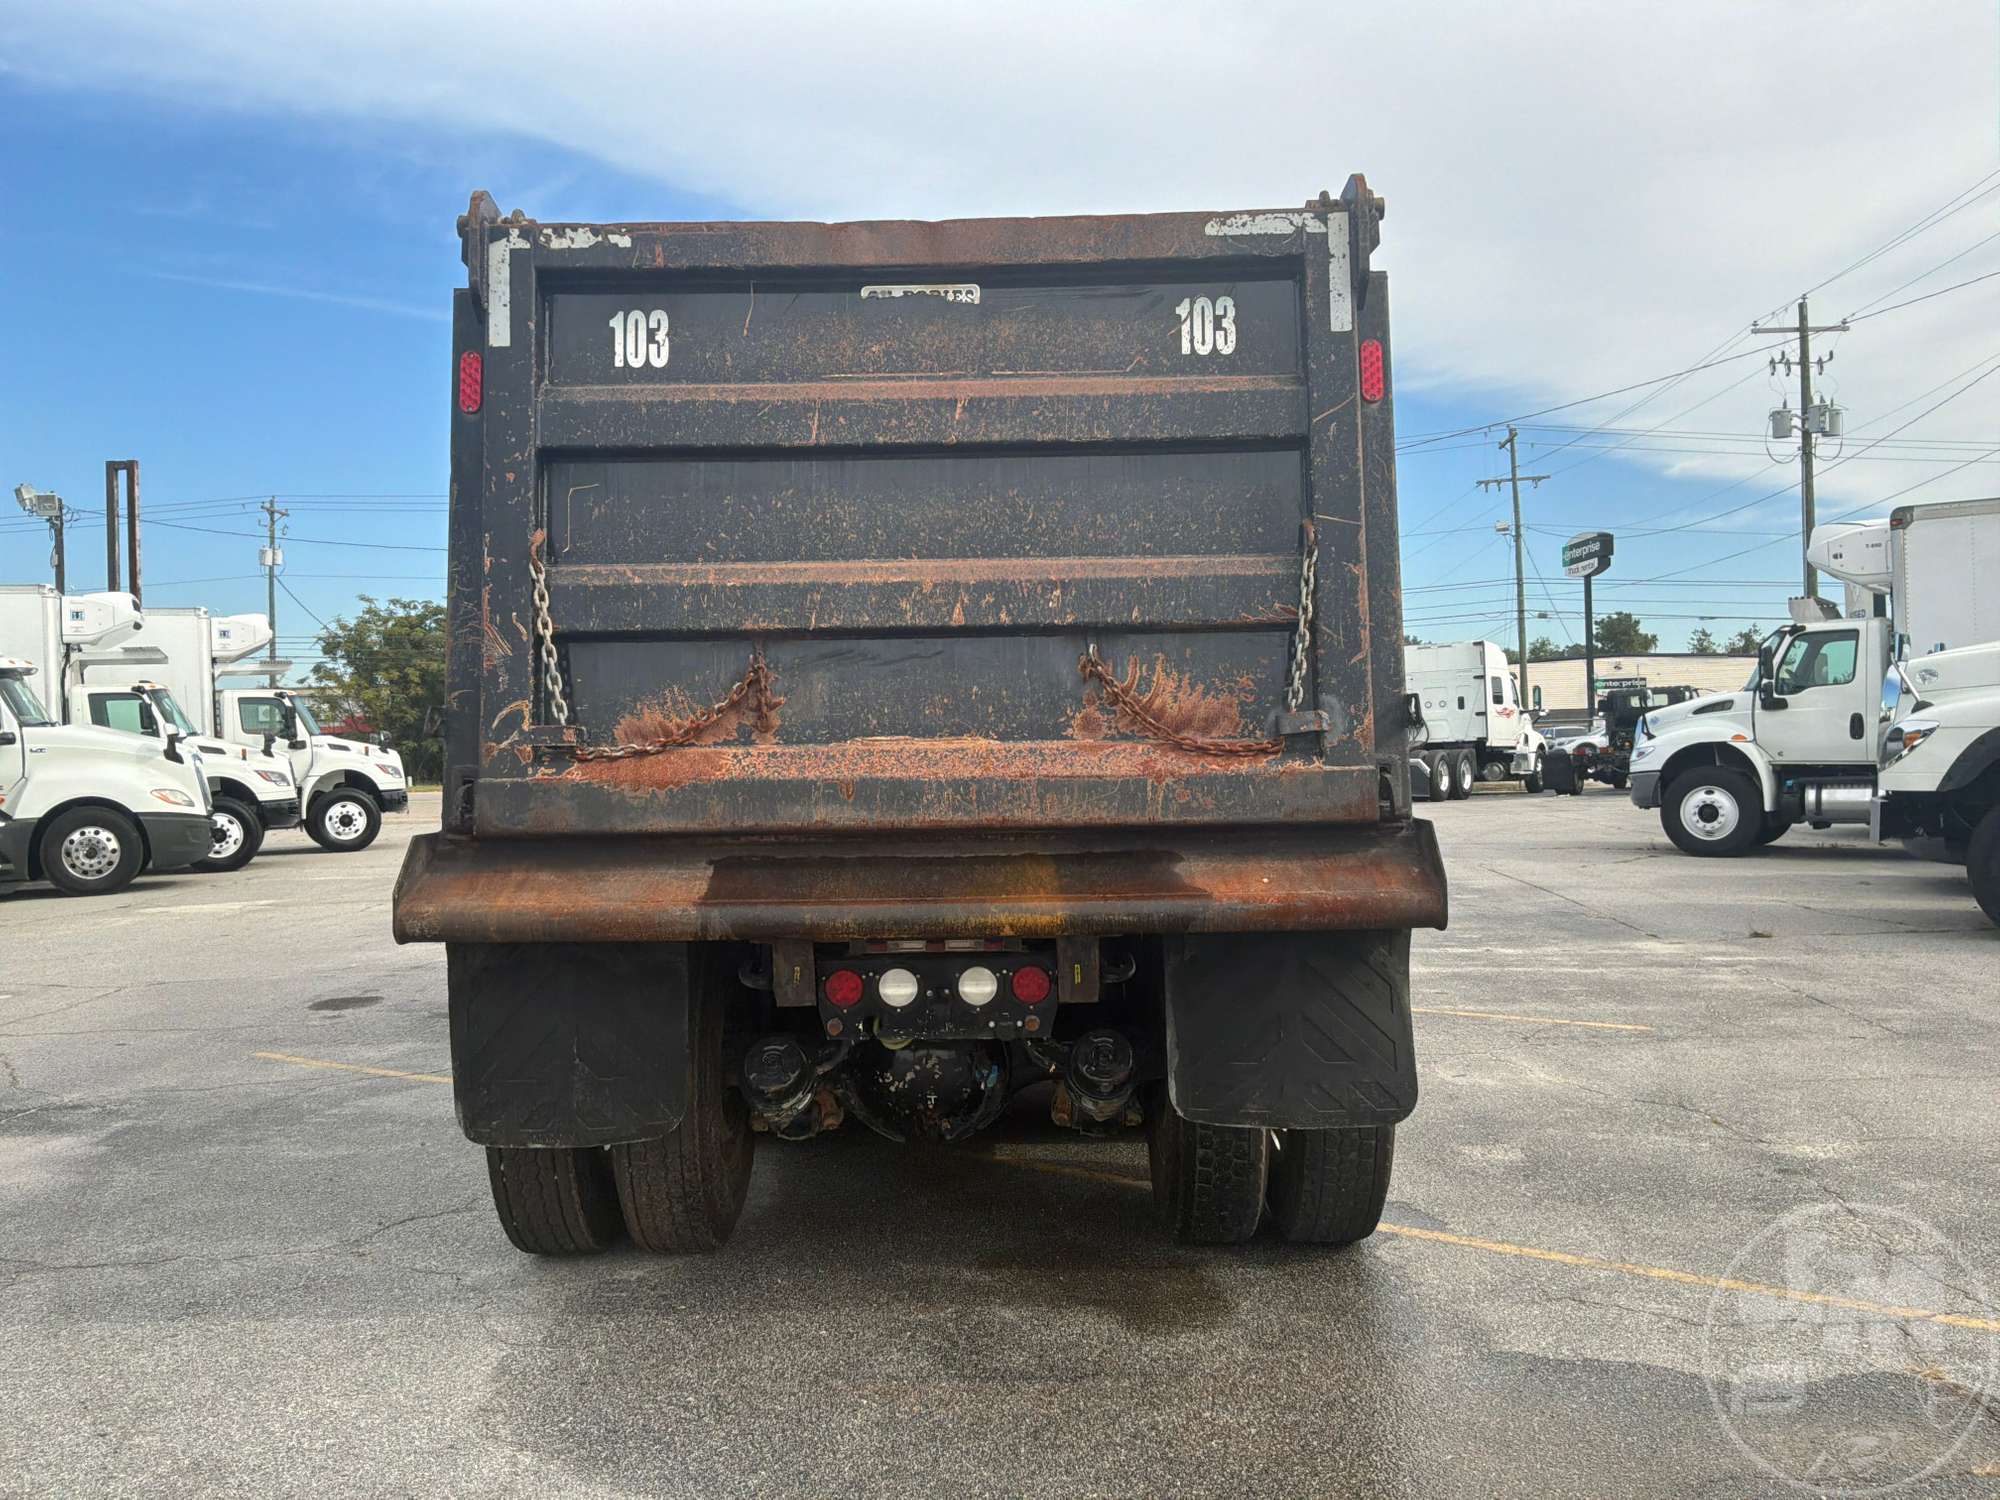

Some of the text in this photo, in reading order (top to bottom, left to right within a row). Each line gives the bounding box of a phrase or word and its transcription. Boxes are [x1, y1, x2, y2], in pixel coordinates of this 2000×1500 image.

[608, 309, 670, 369] 103
[1175, 296, 1236, 356] 103
[1563, 541, 1601, 561] enterprise
[1595, 679, 1646, 688] enterprise
